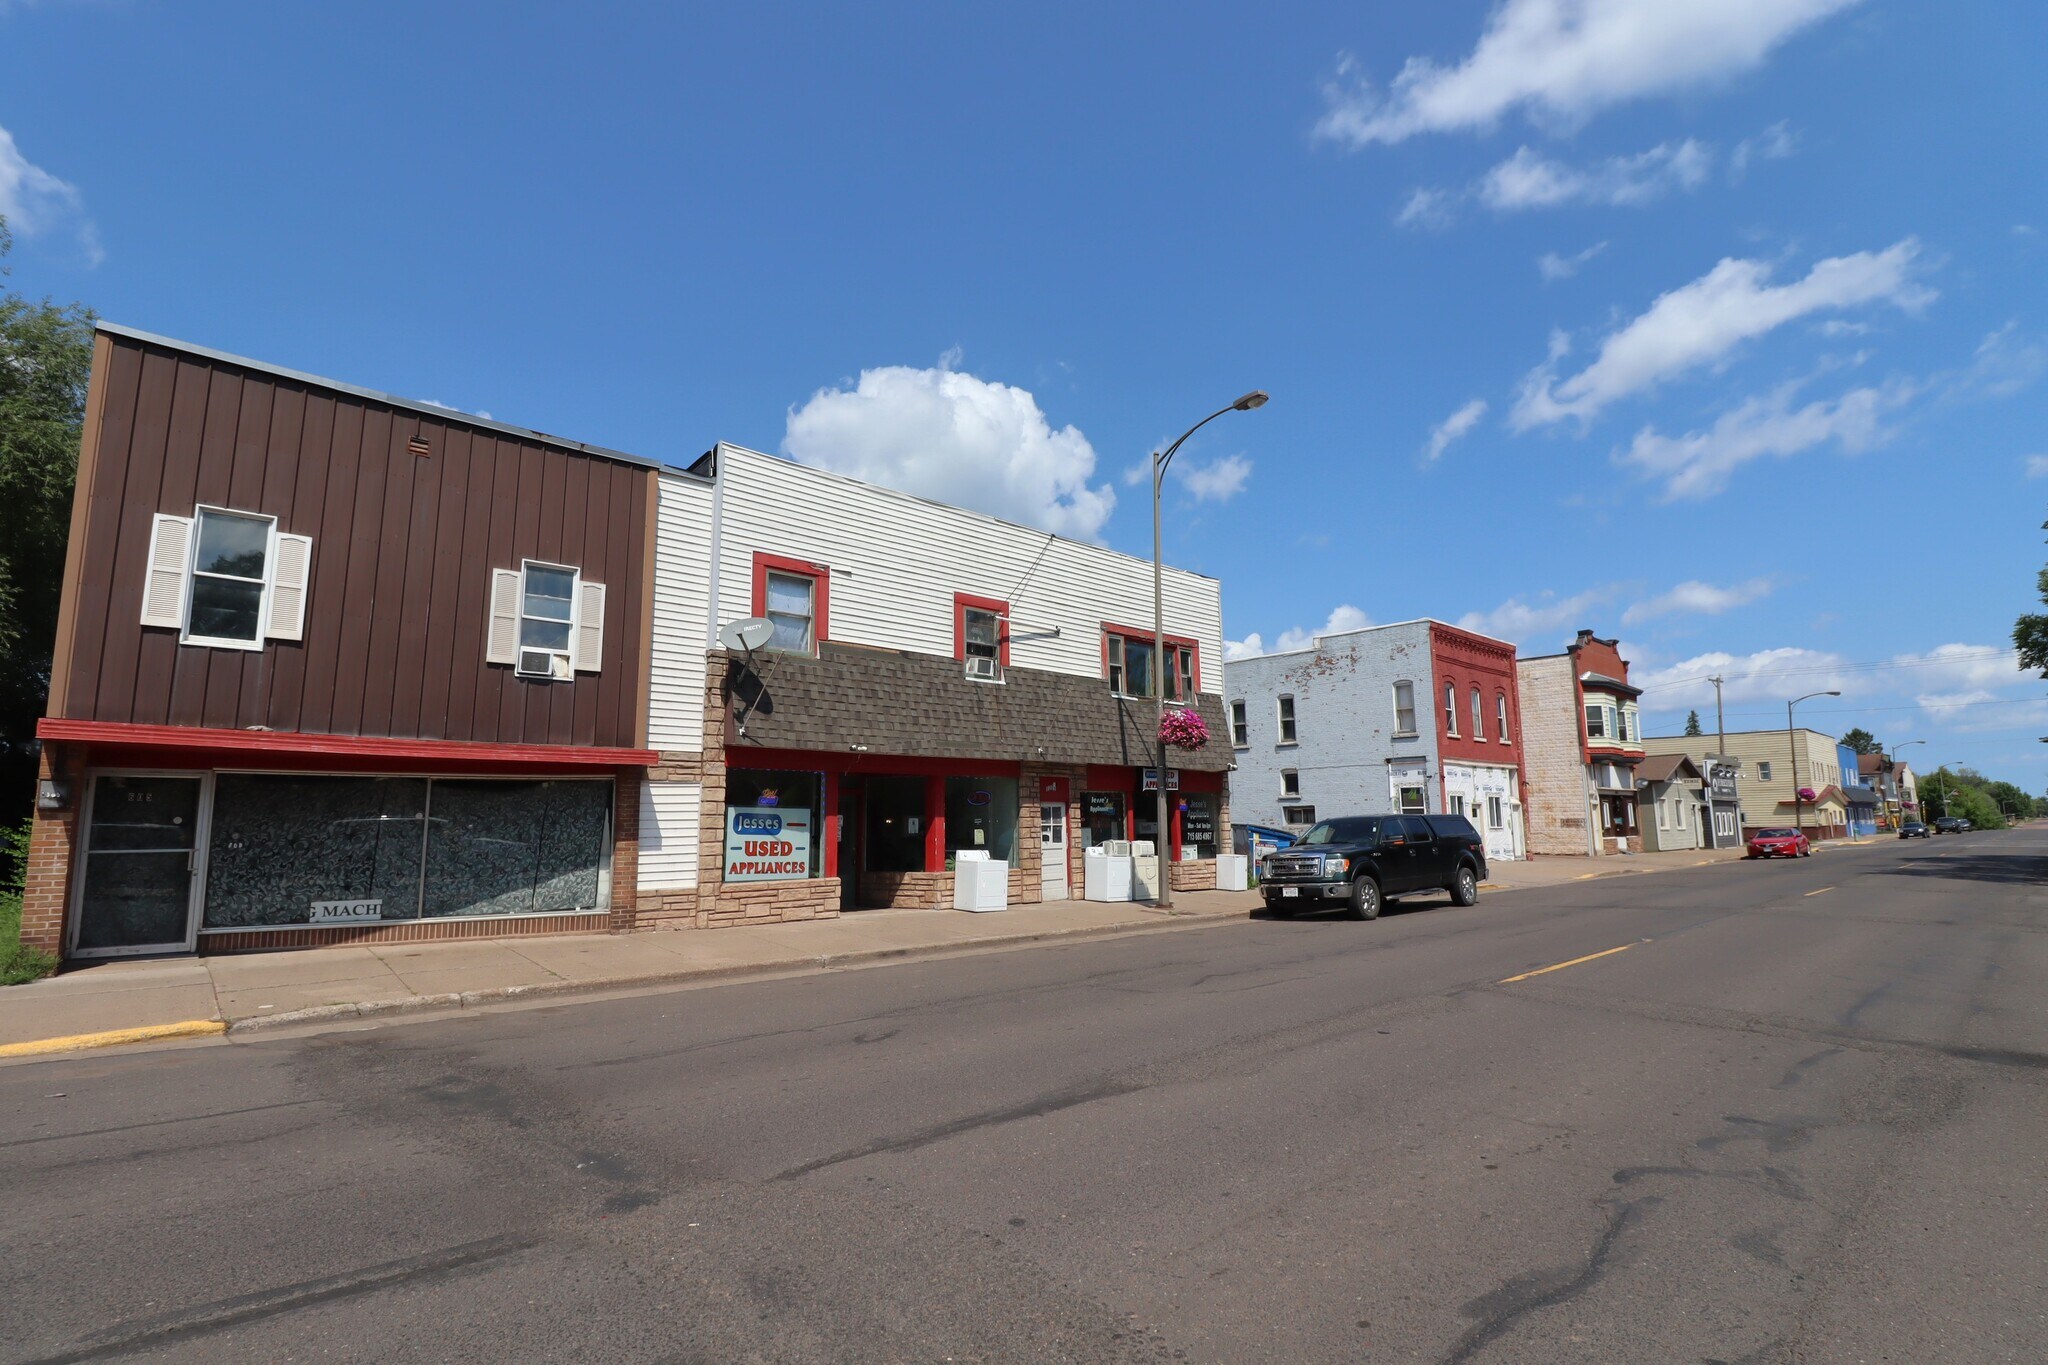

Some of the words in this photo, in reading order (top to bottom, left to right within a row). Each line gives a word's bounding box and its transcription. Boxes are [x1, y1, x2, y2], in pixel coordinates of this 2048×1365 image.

[737, 815, 779, 831] Jesses
[744, 841, 793, 857] USED
[728, 861, 806, 874] APPLIANCES
